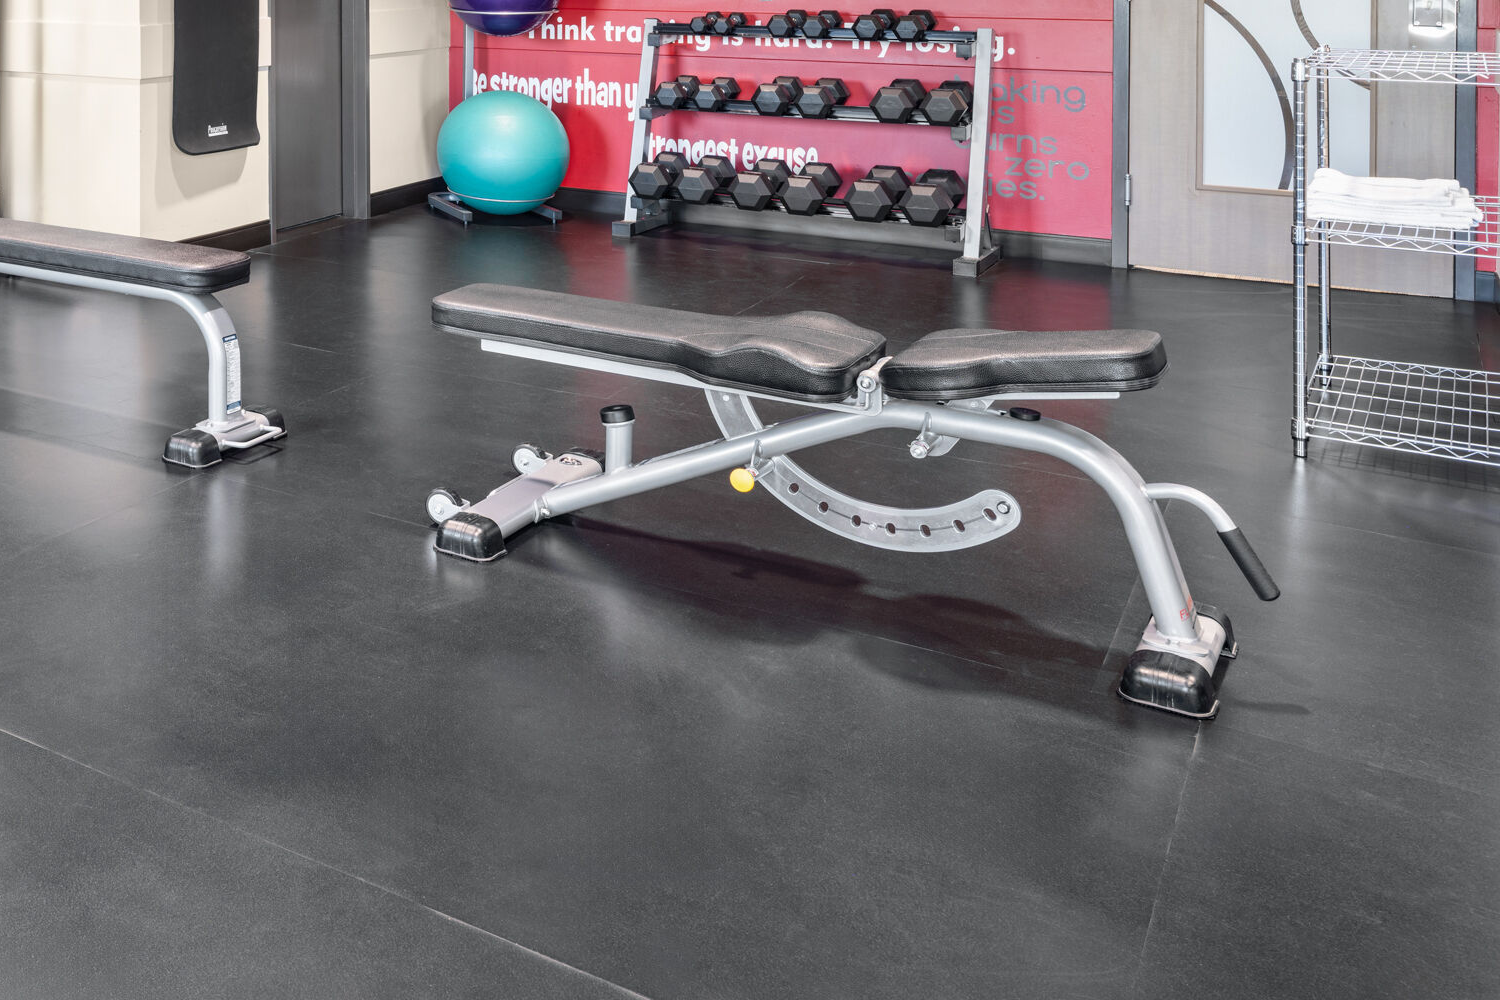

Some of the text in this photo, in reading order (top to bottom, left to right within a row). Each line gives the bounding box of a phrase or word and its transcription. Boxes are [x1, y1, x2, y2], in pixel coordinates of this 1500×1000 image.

[574, 67, 622, 108] than
[953, 74, 1087, 113] aking
[647, 131, 739, 169] trongest
[1003, 156, 1090, 181] zero
